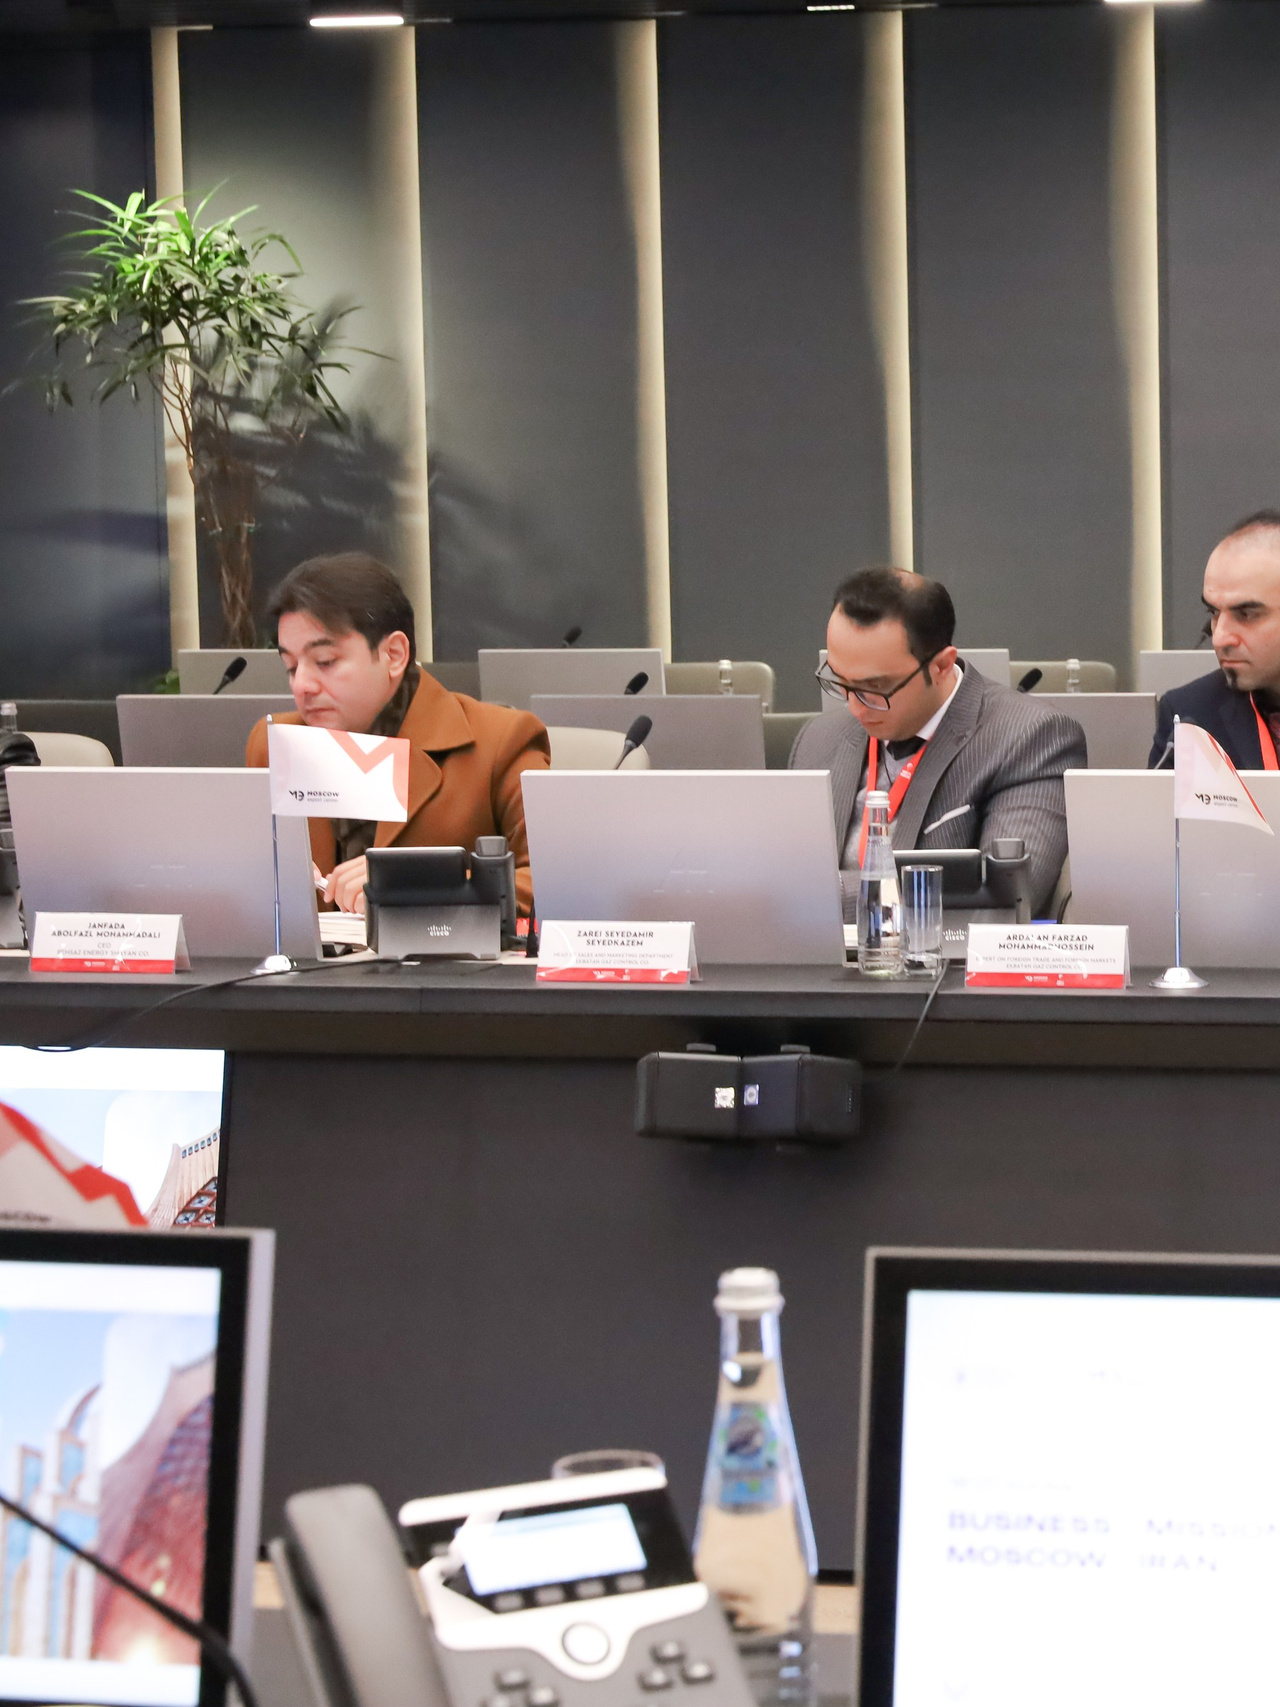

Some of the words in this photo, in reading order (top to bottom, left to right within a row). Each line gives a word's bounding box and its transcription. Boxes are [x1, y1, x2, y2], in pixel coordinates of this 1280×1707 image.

[51, 930, 93, 938] ABOLFAZL
[577, 930, 602, 938] ZAREI
[605, 930, 654, 938] SEYEDAMIR
[1052, 934, 1088, 942] FARZAD
[586, 939, 644, 947] SEYEDKAZEM
